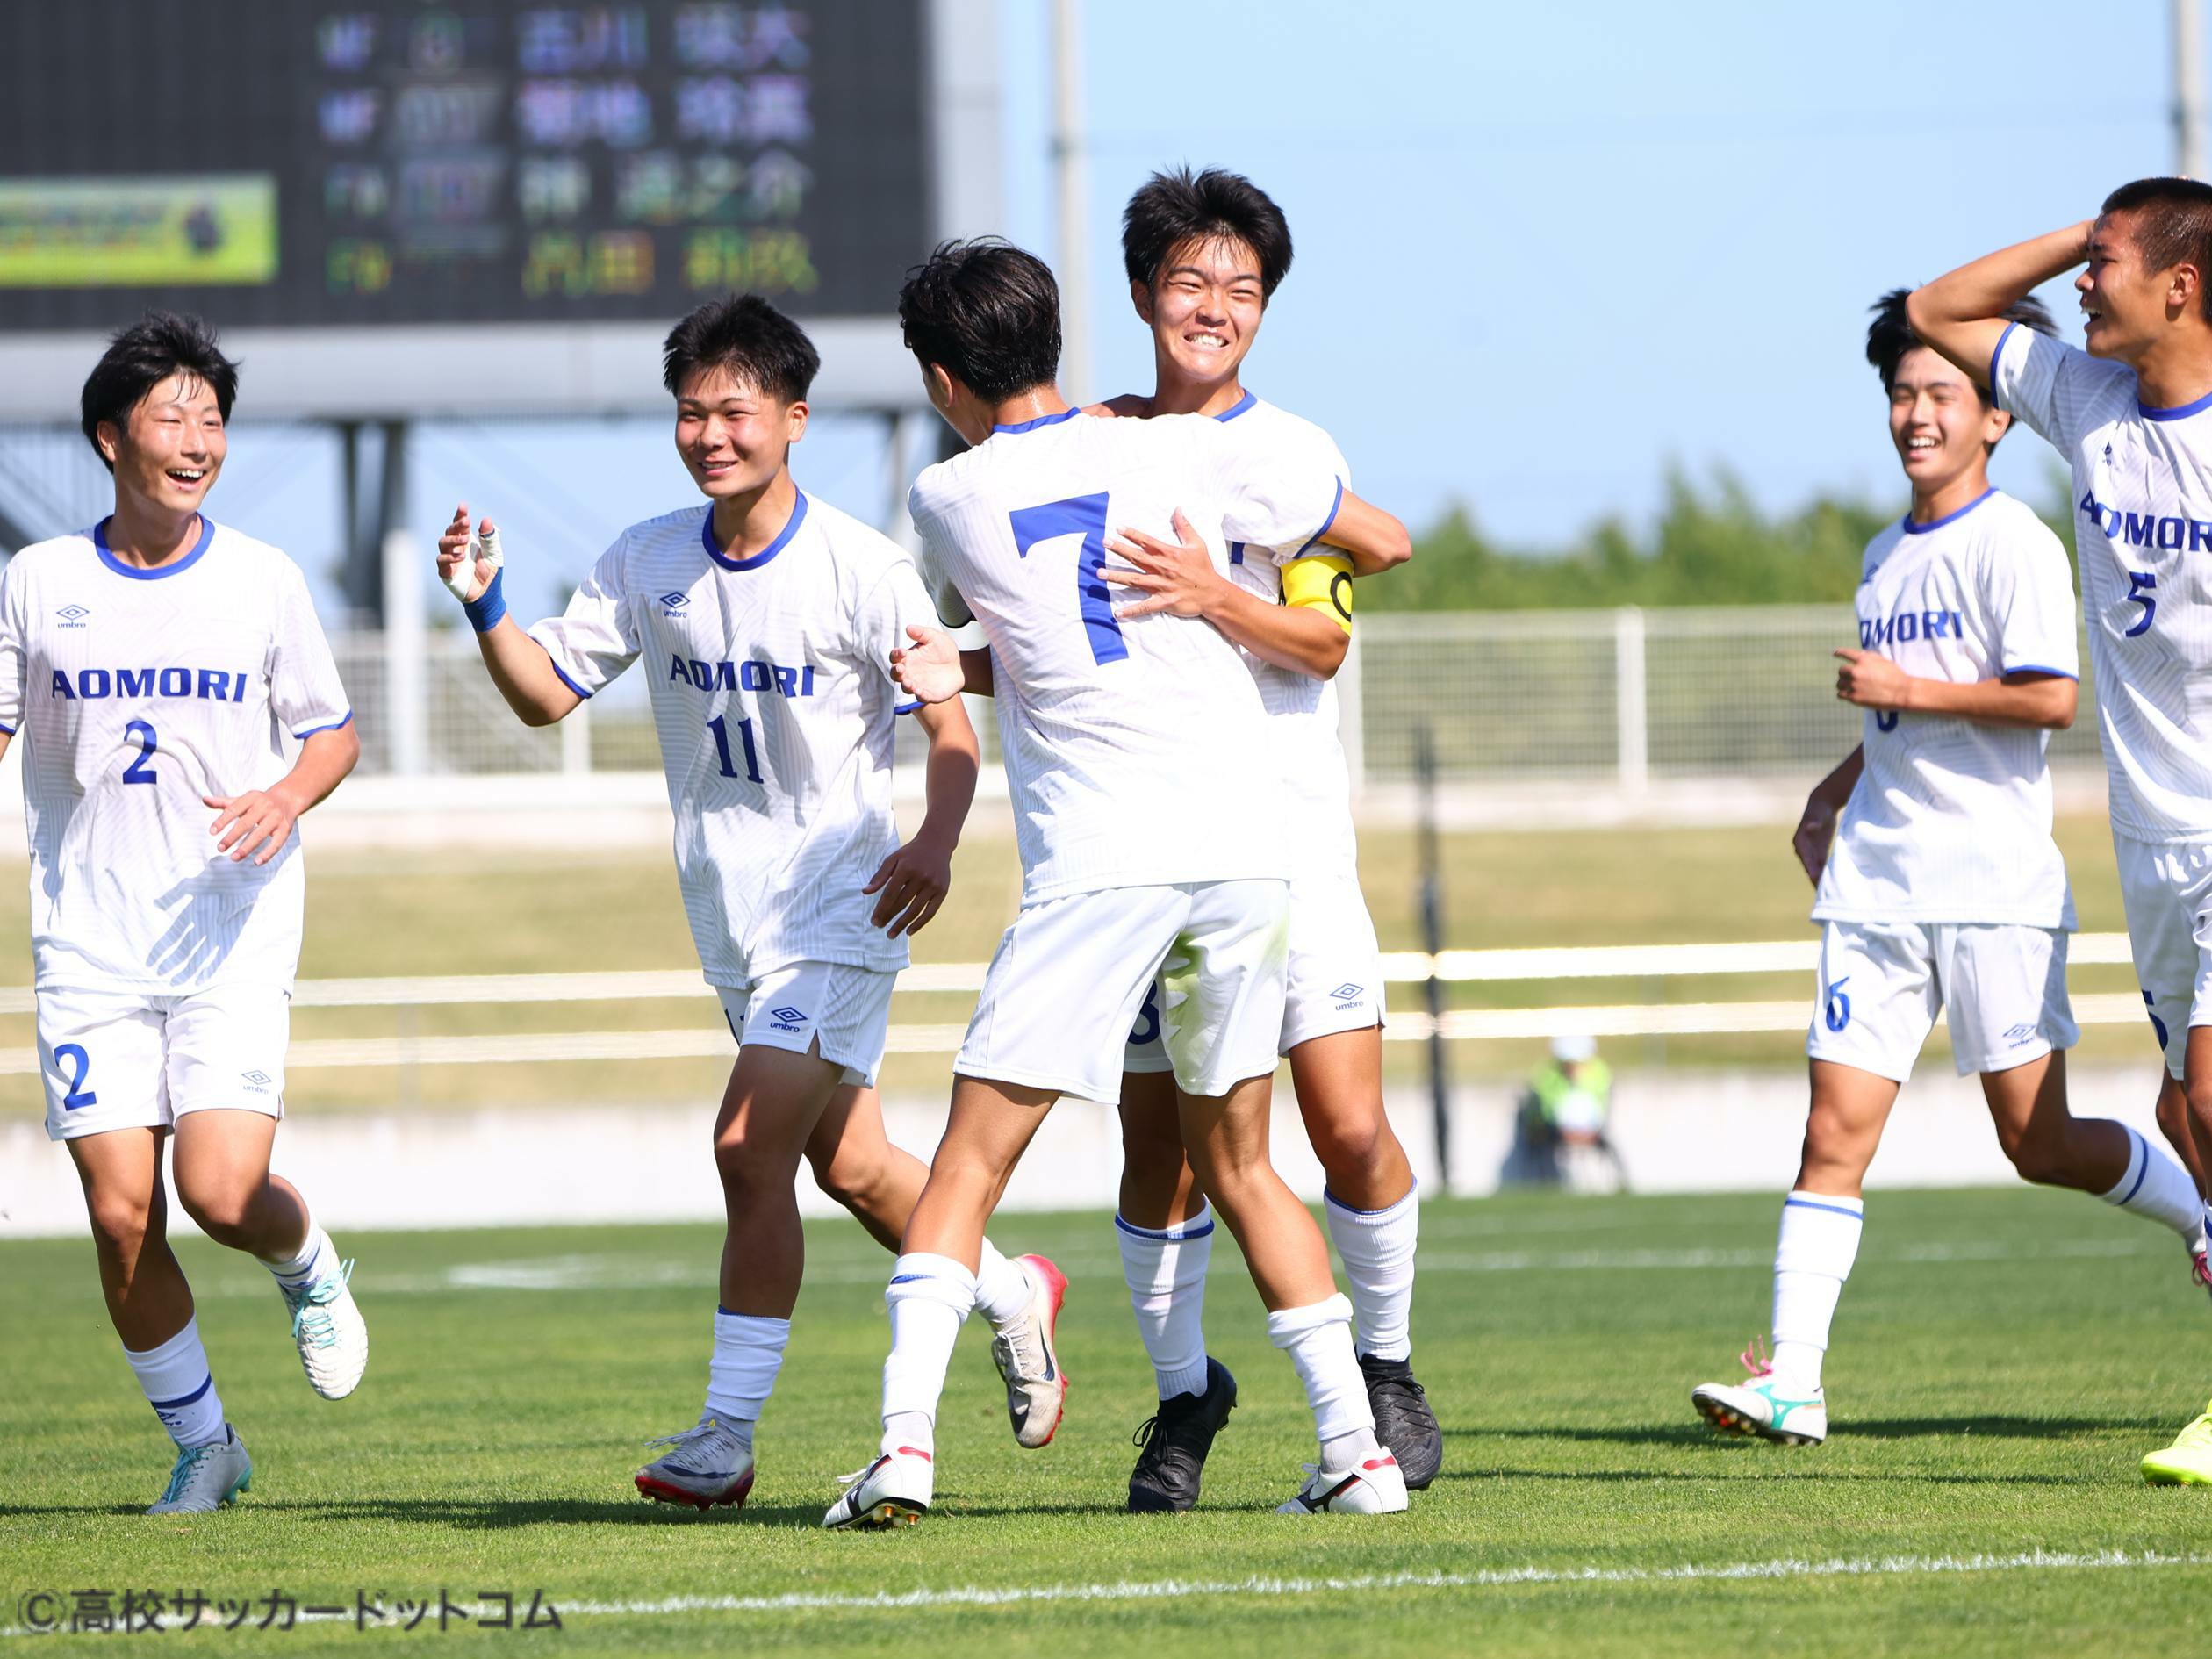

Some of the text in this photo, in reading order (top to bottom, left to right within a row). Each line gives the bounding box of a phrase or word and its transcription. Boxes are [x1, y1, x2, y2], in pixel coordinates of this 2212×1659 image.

[1009, 491, 1129, 665] 7
[2125, 571, 2157, 637] 5
[57, 620, 86, 629] umbro
[52, 668, 247, 702] AOMORI
[670, 654, 815, 698] AOMORI
[123, 721, 157, 784] 2
[707, 715, 764, 784] 11
[770, 1022, 800, 1032] umbro
[1335, 1001, 1364, 1010] umbro
[1826, 976, 1850, 1031] 6
[54, 1043, 97, 1111] 2
